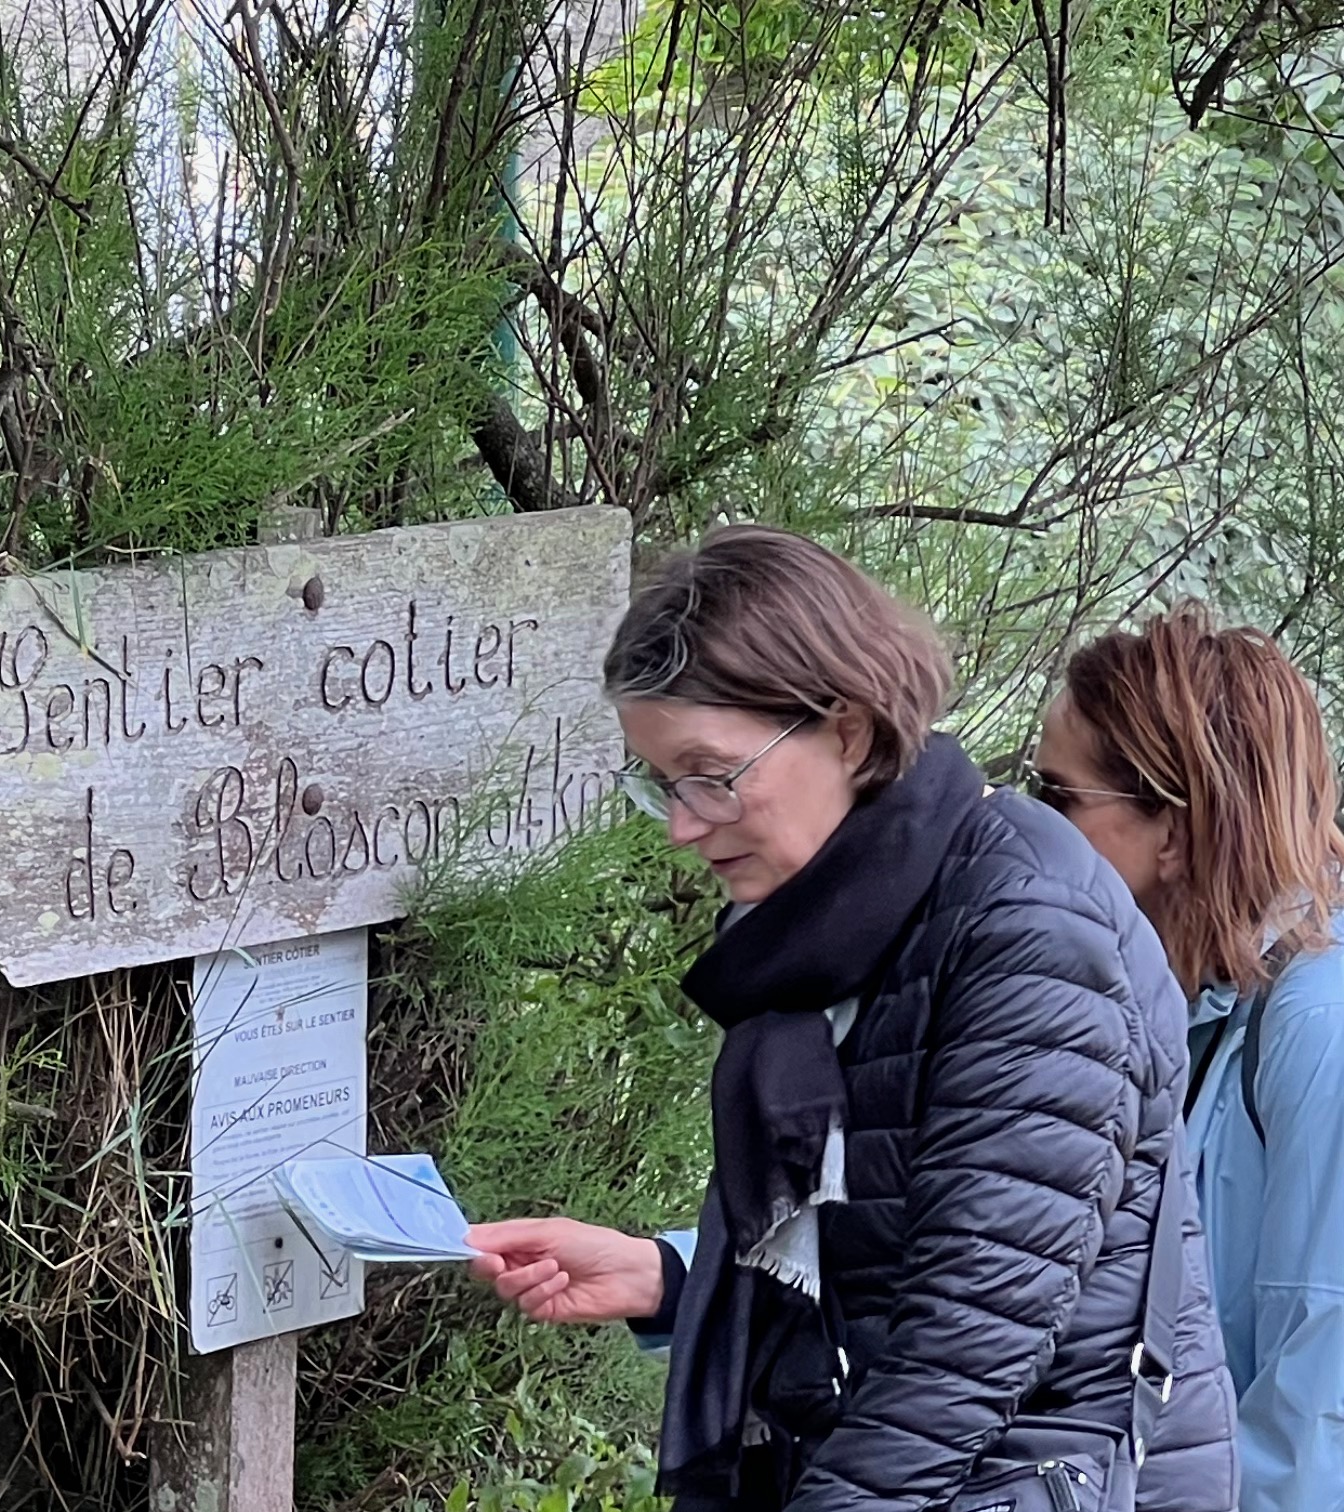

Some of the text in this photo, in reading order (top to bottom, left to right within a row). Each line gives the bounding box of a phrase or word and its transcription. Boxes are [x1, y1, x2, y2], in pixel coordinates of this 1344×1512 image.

[66, 785, 137, 920] de
[187, 756, 460, 901] Blascon
[234, 1009, 355, 1042] VOUS ÊTES SUR LE SENTIER
[234, 1059, 327, 1088] MAUVAISE DIRECTION
[211, 1111, 237, 1130] AVIS
[240, 1103, 265, 1123] AUX
[267, 1086, 351, 1117] PROMENEURS
